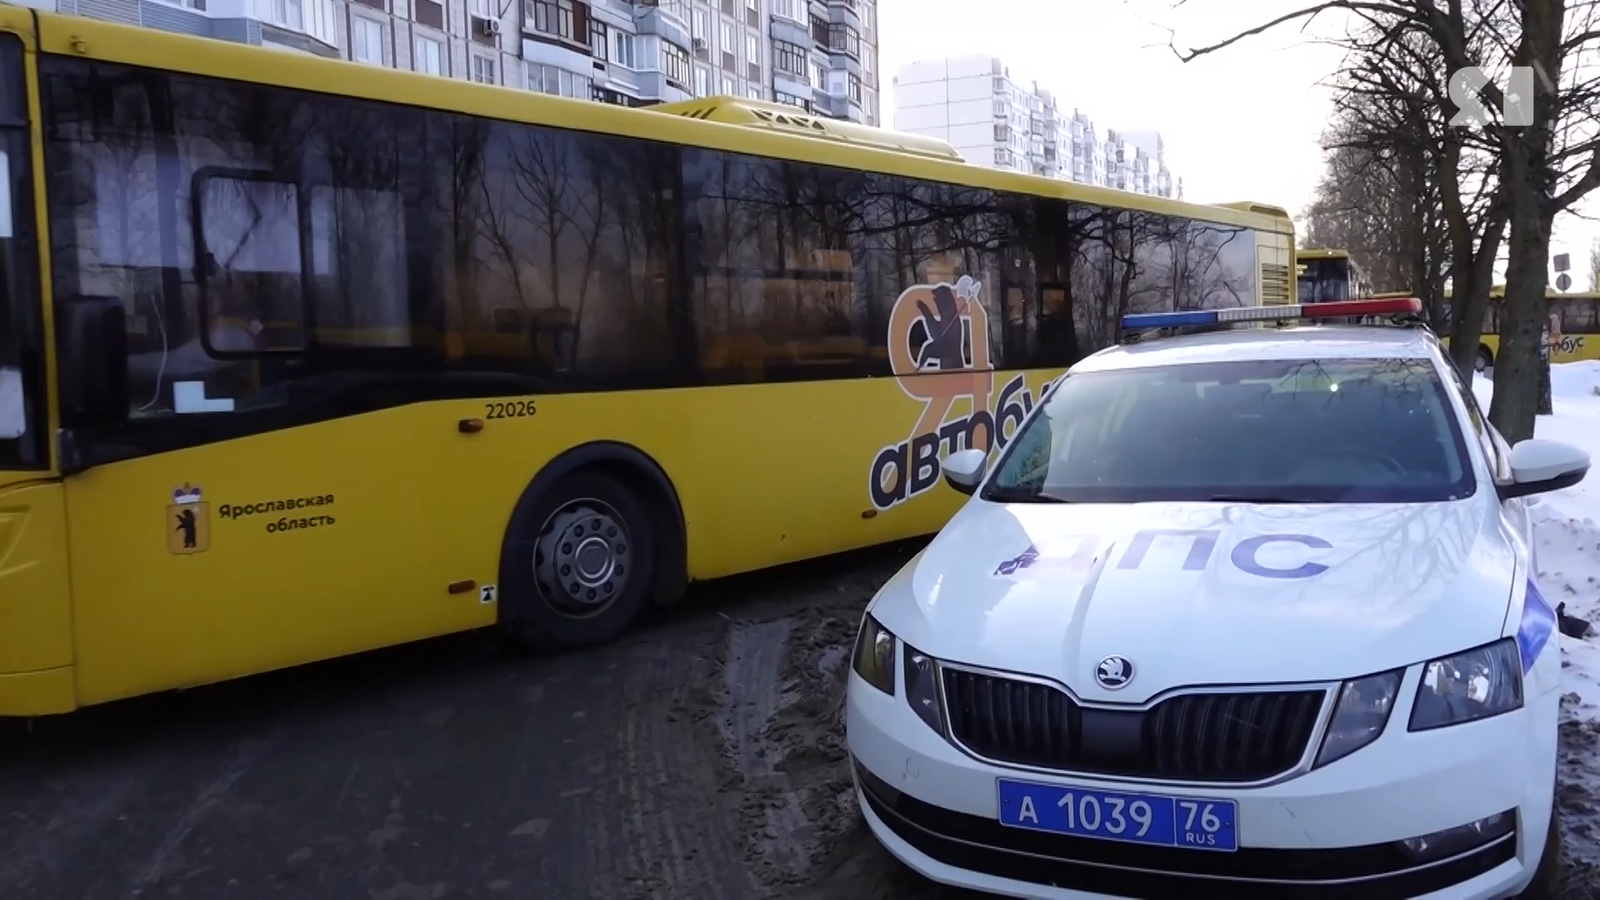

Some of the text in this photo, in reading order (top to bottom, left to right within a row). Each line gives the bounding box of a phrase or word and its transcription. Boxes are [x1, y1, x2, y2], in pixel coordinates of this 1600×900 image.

[485, 400, 536, 420] 22026
[870, 373, 1058, 510] автоб
[219, 494, 335, 520] Ярославская
[266, 515, 336, 534] область
[1057, 792, 1153, 837] 1039
[1179, 801, 1221, 833] 76
[1186, 832, 1216, 845] RUS
